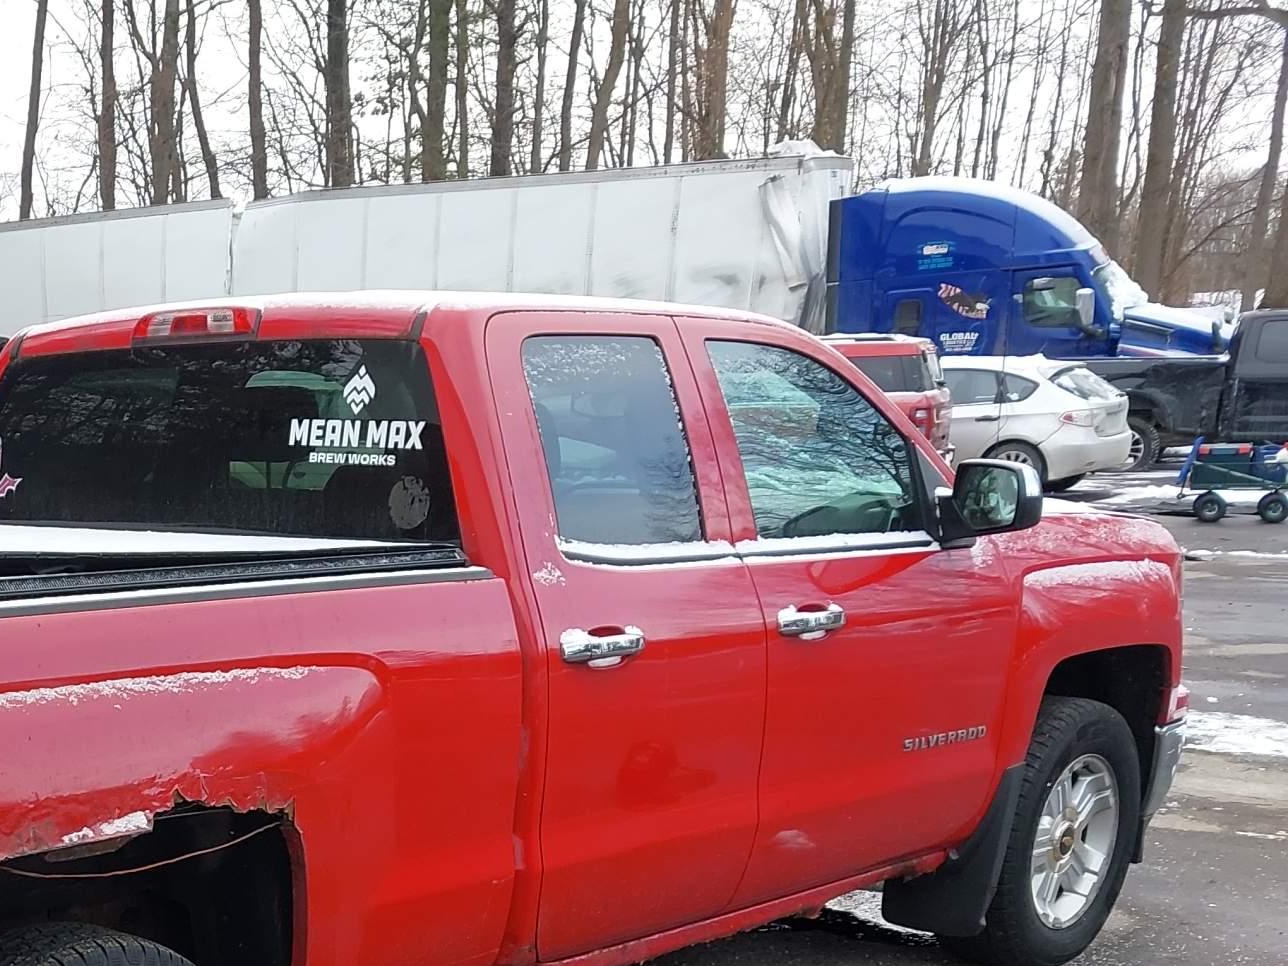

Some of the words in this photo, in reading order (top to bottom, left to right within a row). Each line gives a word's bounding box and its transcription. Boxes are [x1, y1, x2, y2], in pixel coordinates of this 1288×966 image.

[288, 418, 361, 448] MEAN
[366, 420, 426, 450] MAX
[309, 452, 347, 464] BREW
[348, 454, 396, 466] WORKS
[903, 725, 987, 752] SILVERADO
